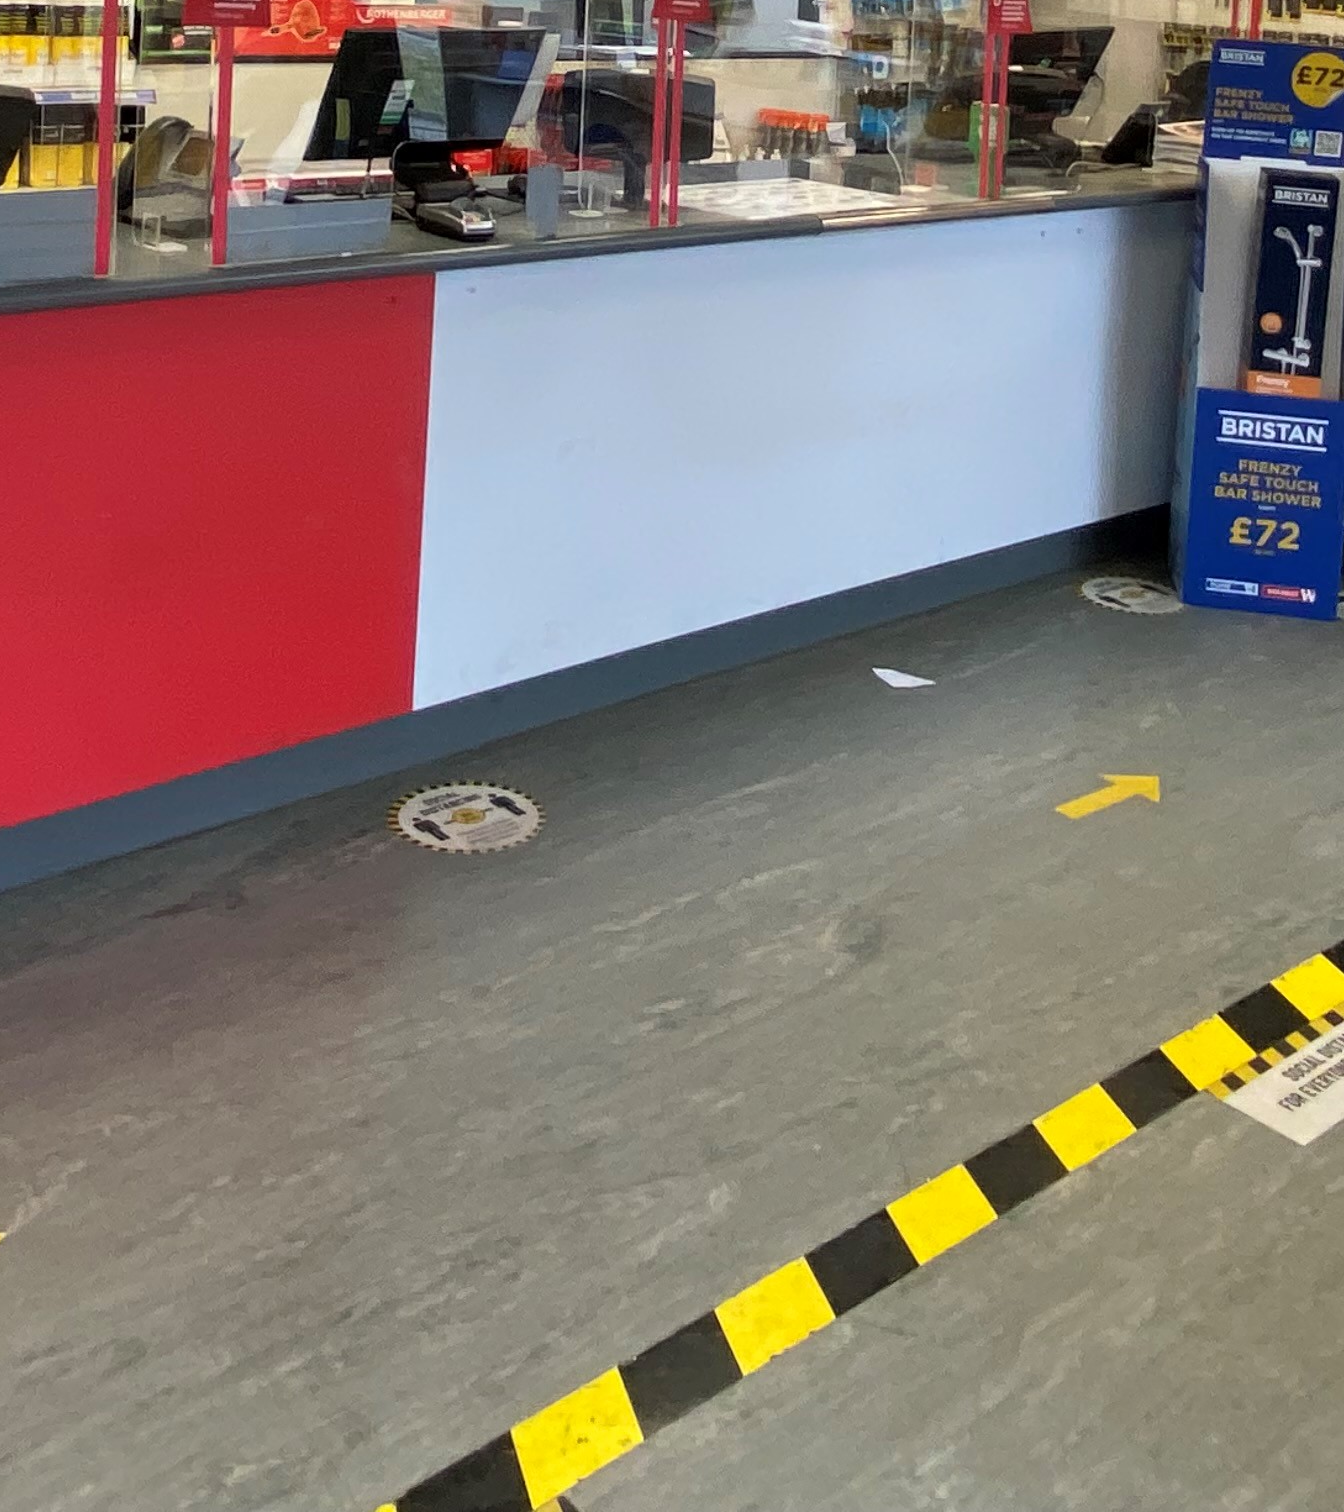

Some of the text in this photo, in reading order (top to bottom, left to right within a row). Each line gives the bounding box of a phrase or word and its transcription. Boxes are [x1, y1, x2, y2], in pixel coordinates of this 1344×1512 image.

[367, 9, 446, 19] ROTHENBERGER
[1221, 50, 1264, 63] BRISTAN
[1274, 189, 1328, 204] BRISTAN
[1221, 417, 1324, 445] BRISTAN
[1238, 459, 1303, 477] FRENZY
[1219, 472, 1319, 493] SAFE TOUCH
[1214, 486, 1247, 500] BAR
[1251, 490, 1322, 509] SHOWER
[1229, 516, 1300, 550] £72
[1281, 1052, 1326, 1082] SOCIAL
[1278, 1089, 1309, 1112] FOR
